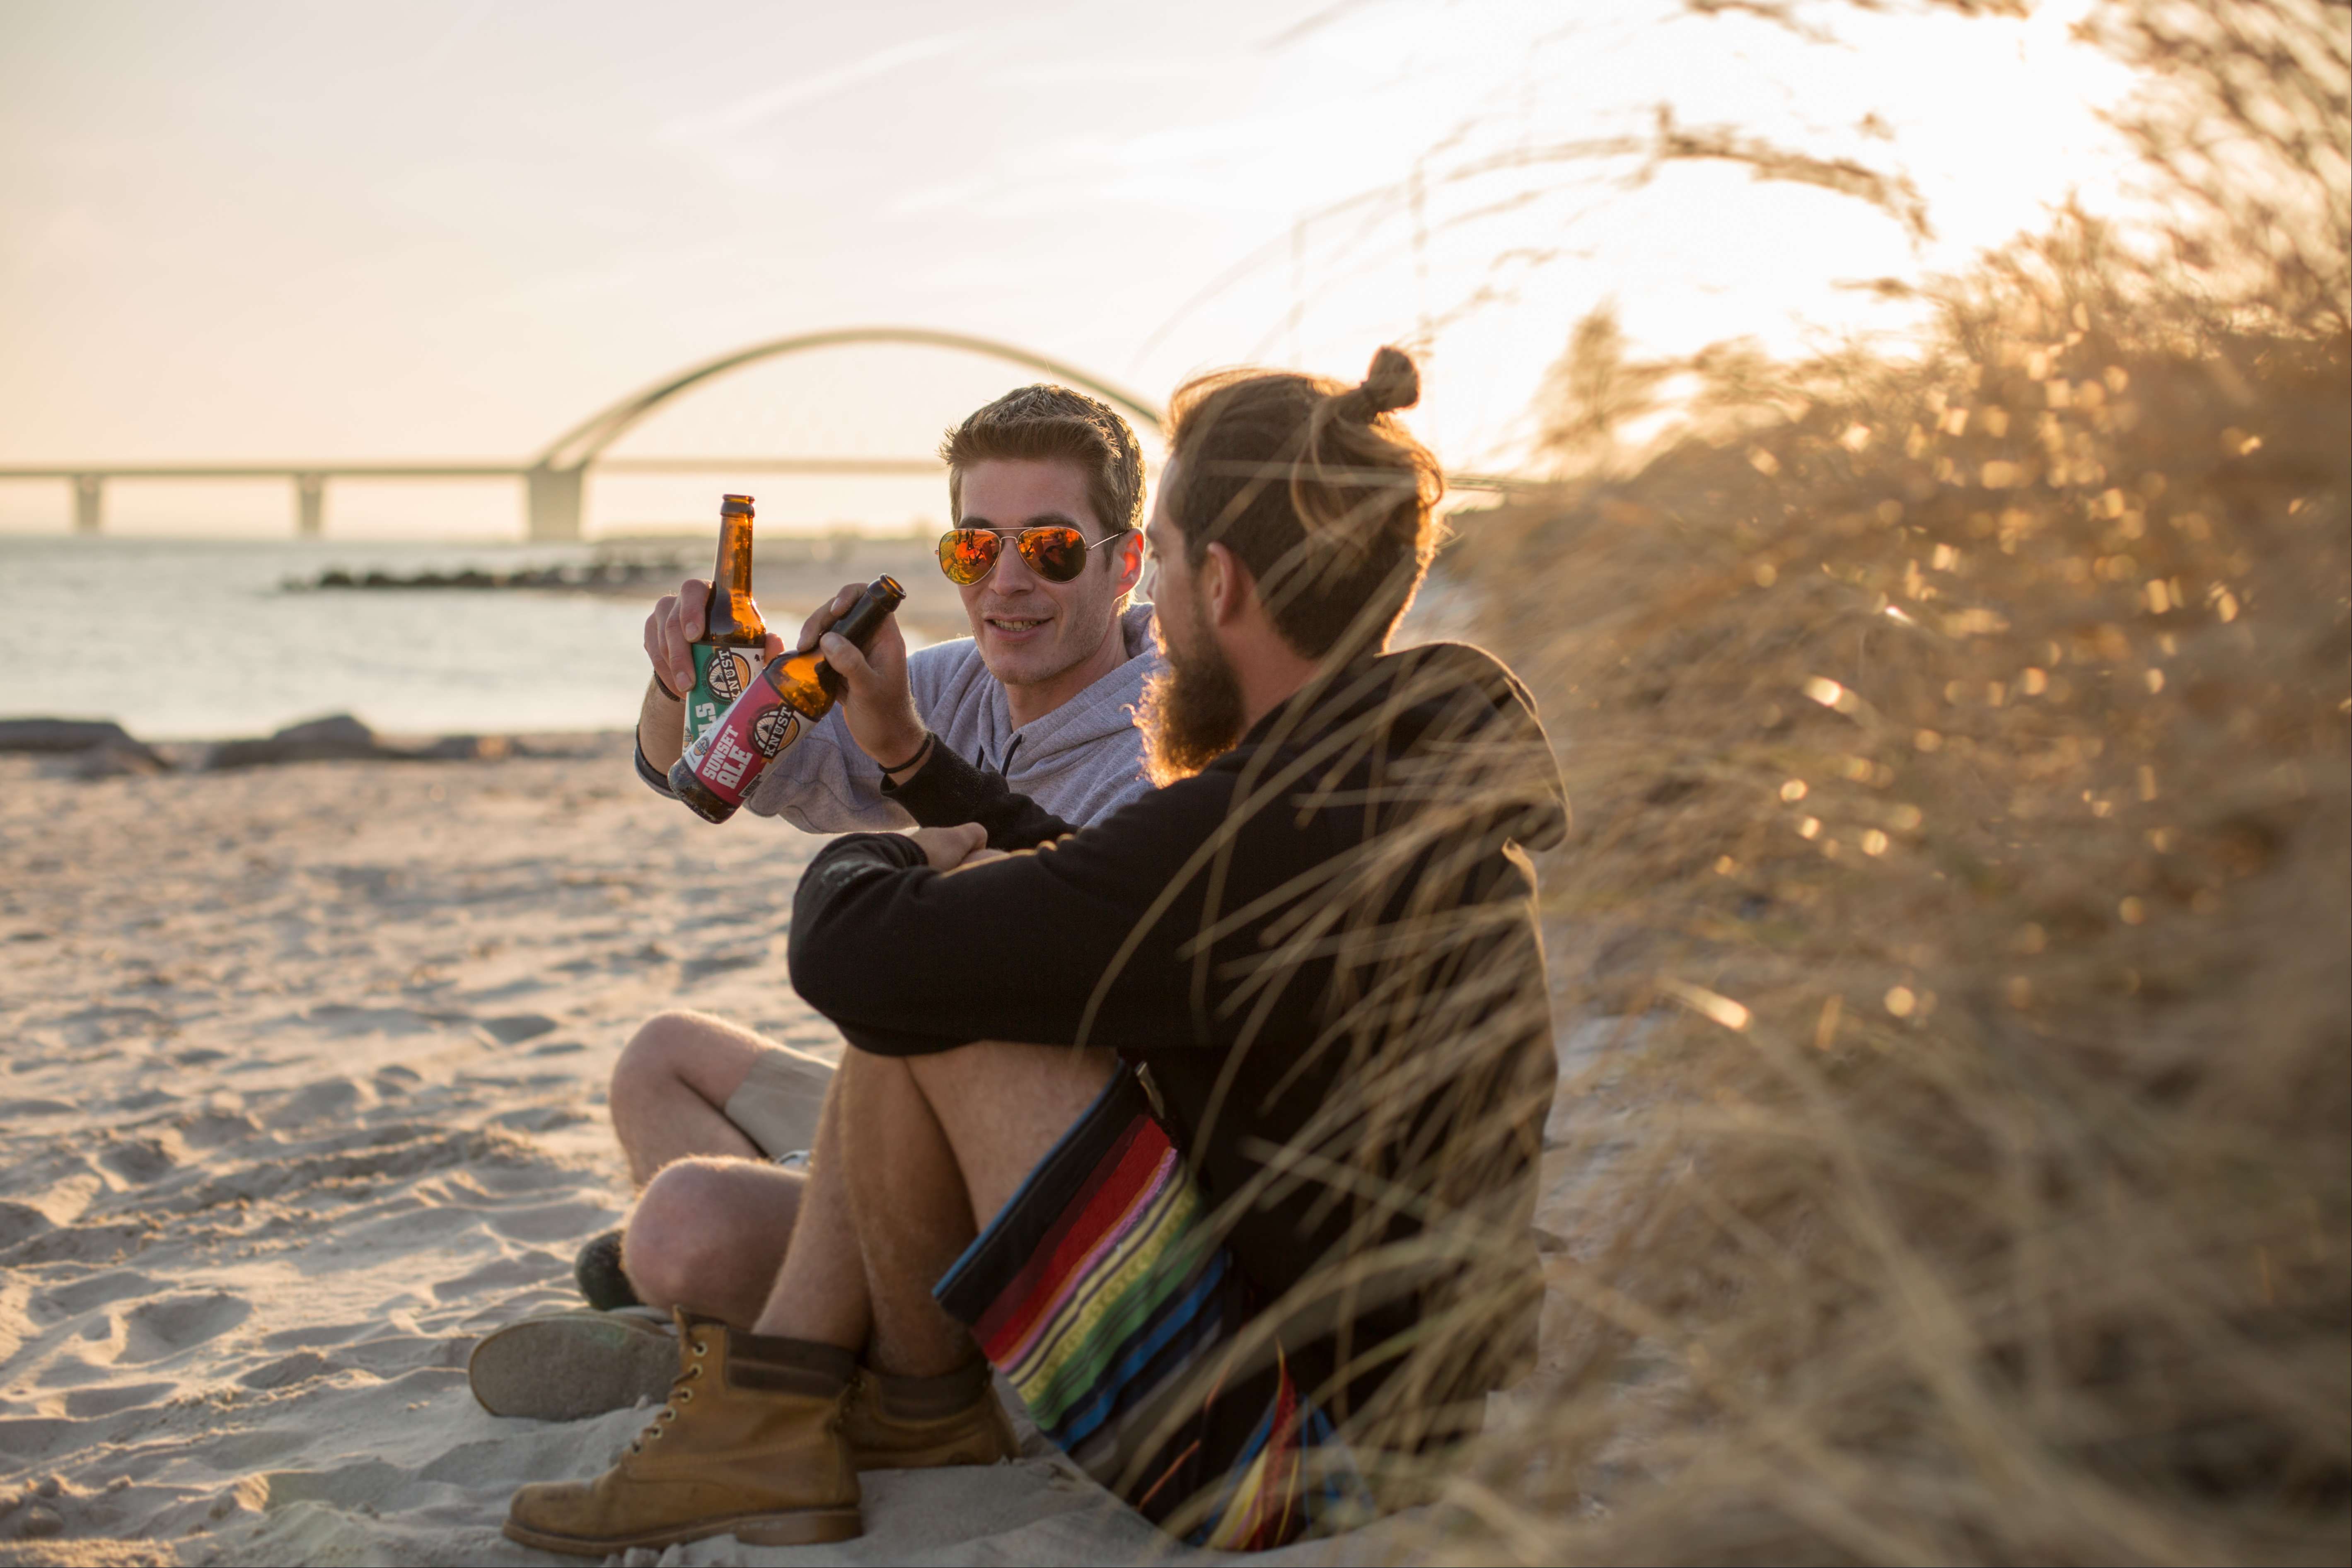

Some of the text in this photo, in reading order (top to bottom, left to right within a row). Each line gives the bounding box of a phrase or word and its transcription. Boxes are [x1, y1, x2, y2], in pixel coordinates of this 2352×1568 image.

[718, 650, 741, 701] KNUST
[702, 725, 739, 780] SUNSET
[764, 706, 791, 757] KNUST
[716, 745, 753, 789] ALE
